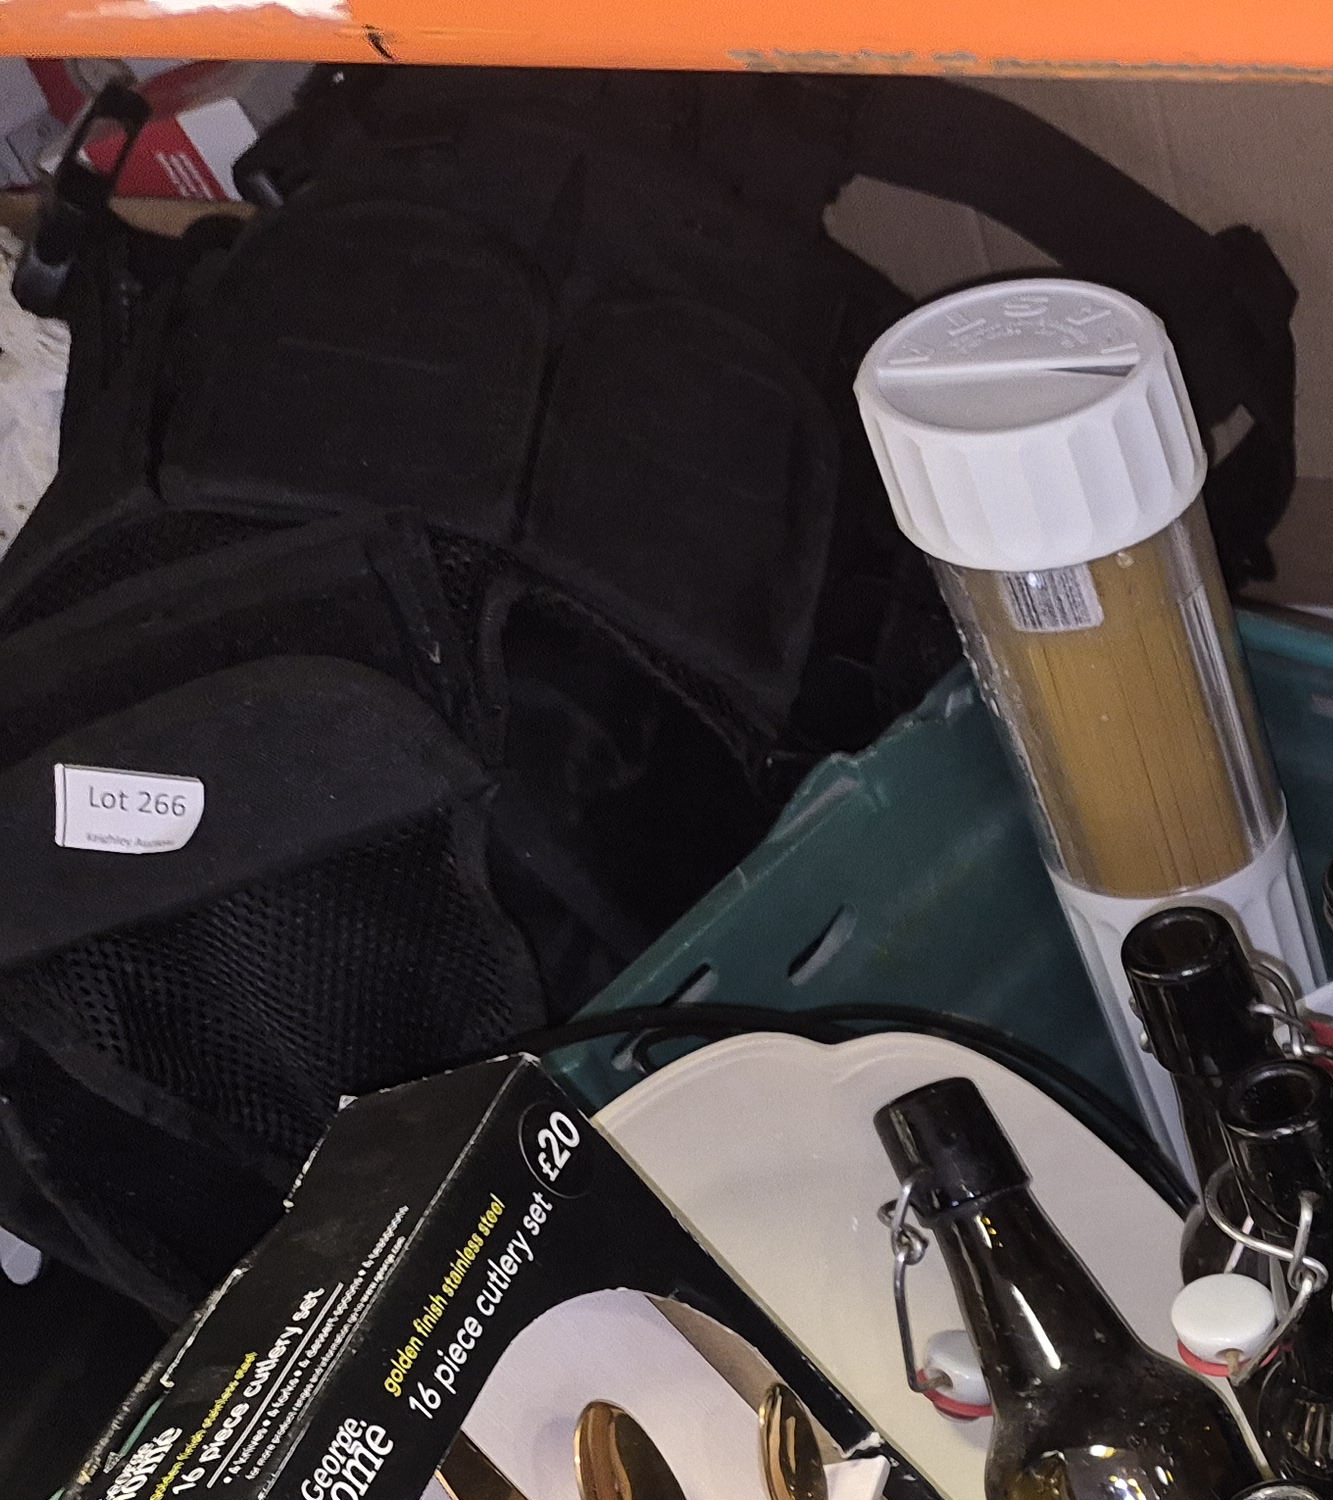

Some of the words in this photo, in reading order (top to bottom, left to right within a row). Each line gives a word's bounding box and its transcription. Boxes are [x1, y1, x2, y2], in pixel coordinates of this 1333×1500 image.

[88, 785, 129, 811] Lot
[138, 791, 186, 817] 266
[537, 1111, 580, 1182] £20
[171, 1467, 206, 1495] 16
[198, 1402, 250, 1463] piece
[242, 1326, 304, 1398] cutlery
[291, 1287, 325, 1322] set
[383, 1336, 424, 1398] golden
[412, 1294, 448, 1338] finish
[441, 1232, 484, 1298] stainless
[477, 1192, 506, 1237] steel
[408, 1381, 442, 1419] 16
[433, 1316, 483, 1395] piece
[476, 1230, 534, 1317] cutlery
[522, 1191, 553, 1236] set
